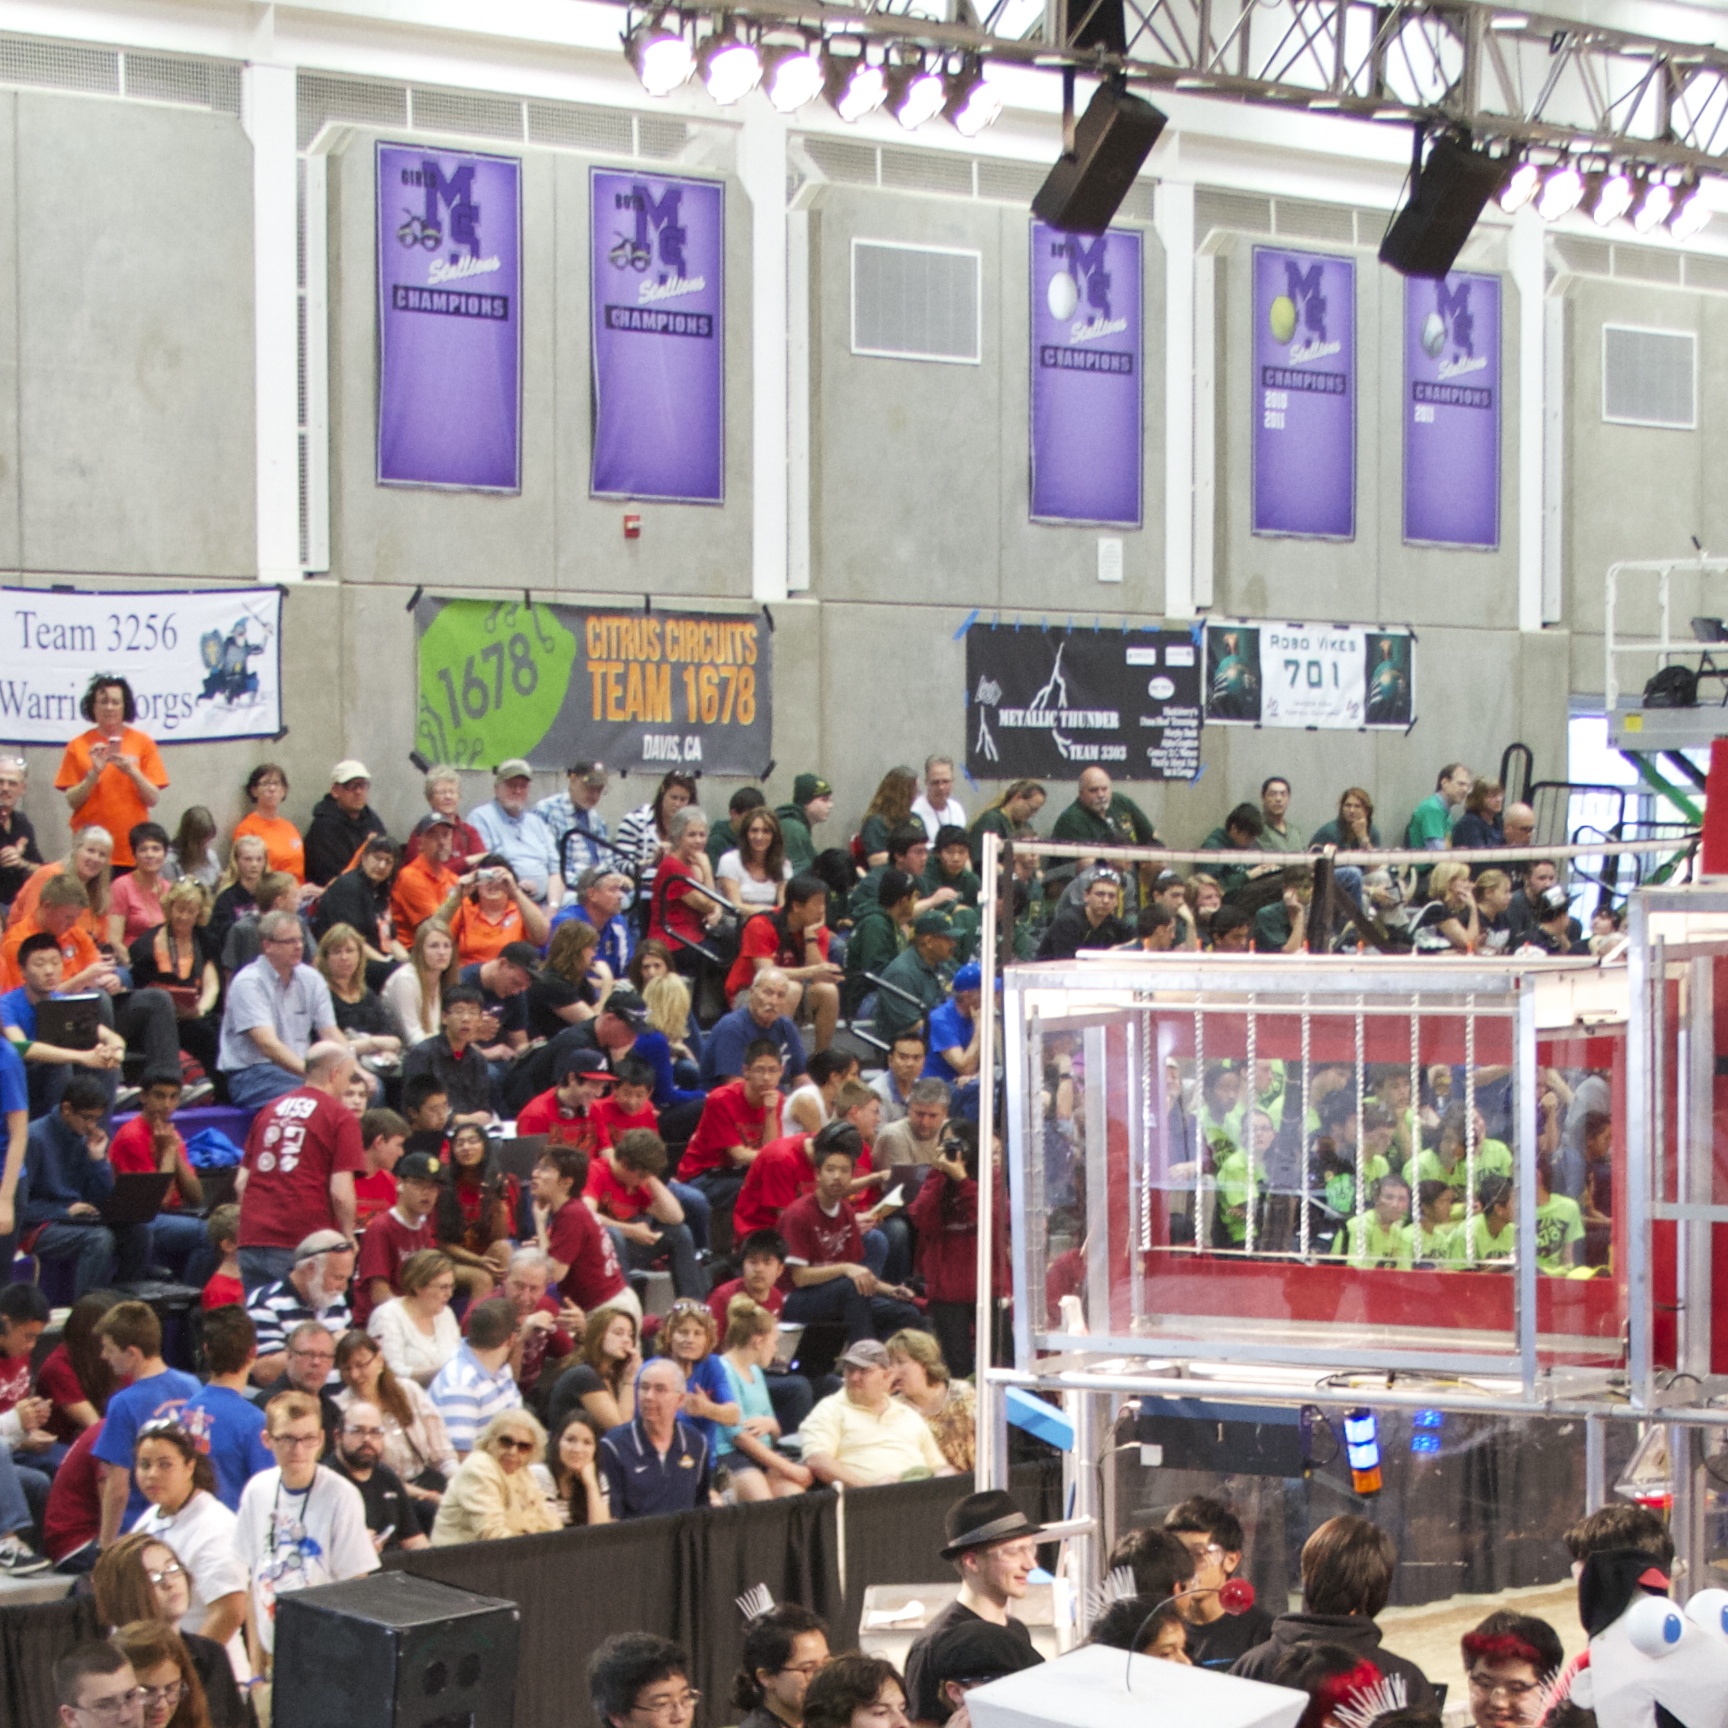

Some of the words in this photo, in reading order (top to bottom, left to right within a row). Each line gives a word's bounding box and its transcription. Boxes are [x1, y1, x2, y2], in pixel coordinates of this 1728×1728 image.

[395, 288, 504, 317] CHAMPIONS
[611, 309, 710, 335] CHAMPIONS
[1043, 349, 1131, 372] CHAMPIONS
[1265, 369, 1344, 394] CHAMPIONS
[1416, 384, 1490, 407] CHAMPIONS
[15, 610, 95, 653] Team
[107, 612, 178, 653] 3256
[585, 615, 661, 661] CITRUS
[665, 619, 758, 665] CIRCUITS
[1271, 635, 1309, 650] ROBO
[1318, 638, 1356, 652] VIKES
[438, 632, 539, 729] 1678
[1284, 659, 1339, 689] 701
[586, 661, 671, 723] TEAM
[682, 665, 757, 726] 1678
[998, 708, 1058, 728] METALLIC
[1059, 709, 1120, 729] THUNDER
[643, 734, 682, 763] DAVIS,
[683, 736, 702, 761] CA
[1069, 745, 1100, 761] TEAM
[275, 1098, 318, 1118] 4159
